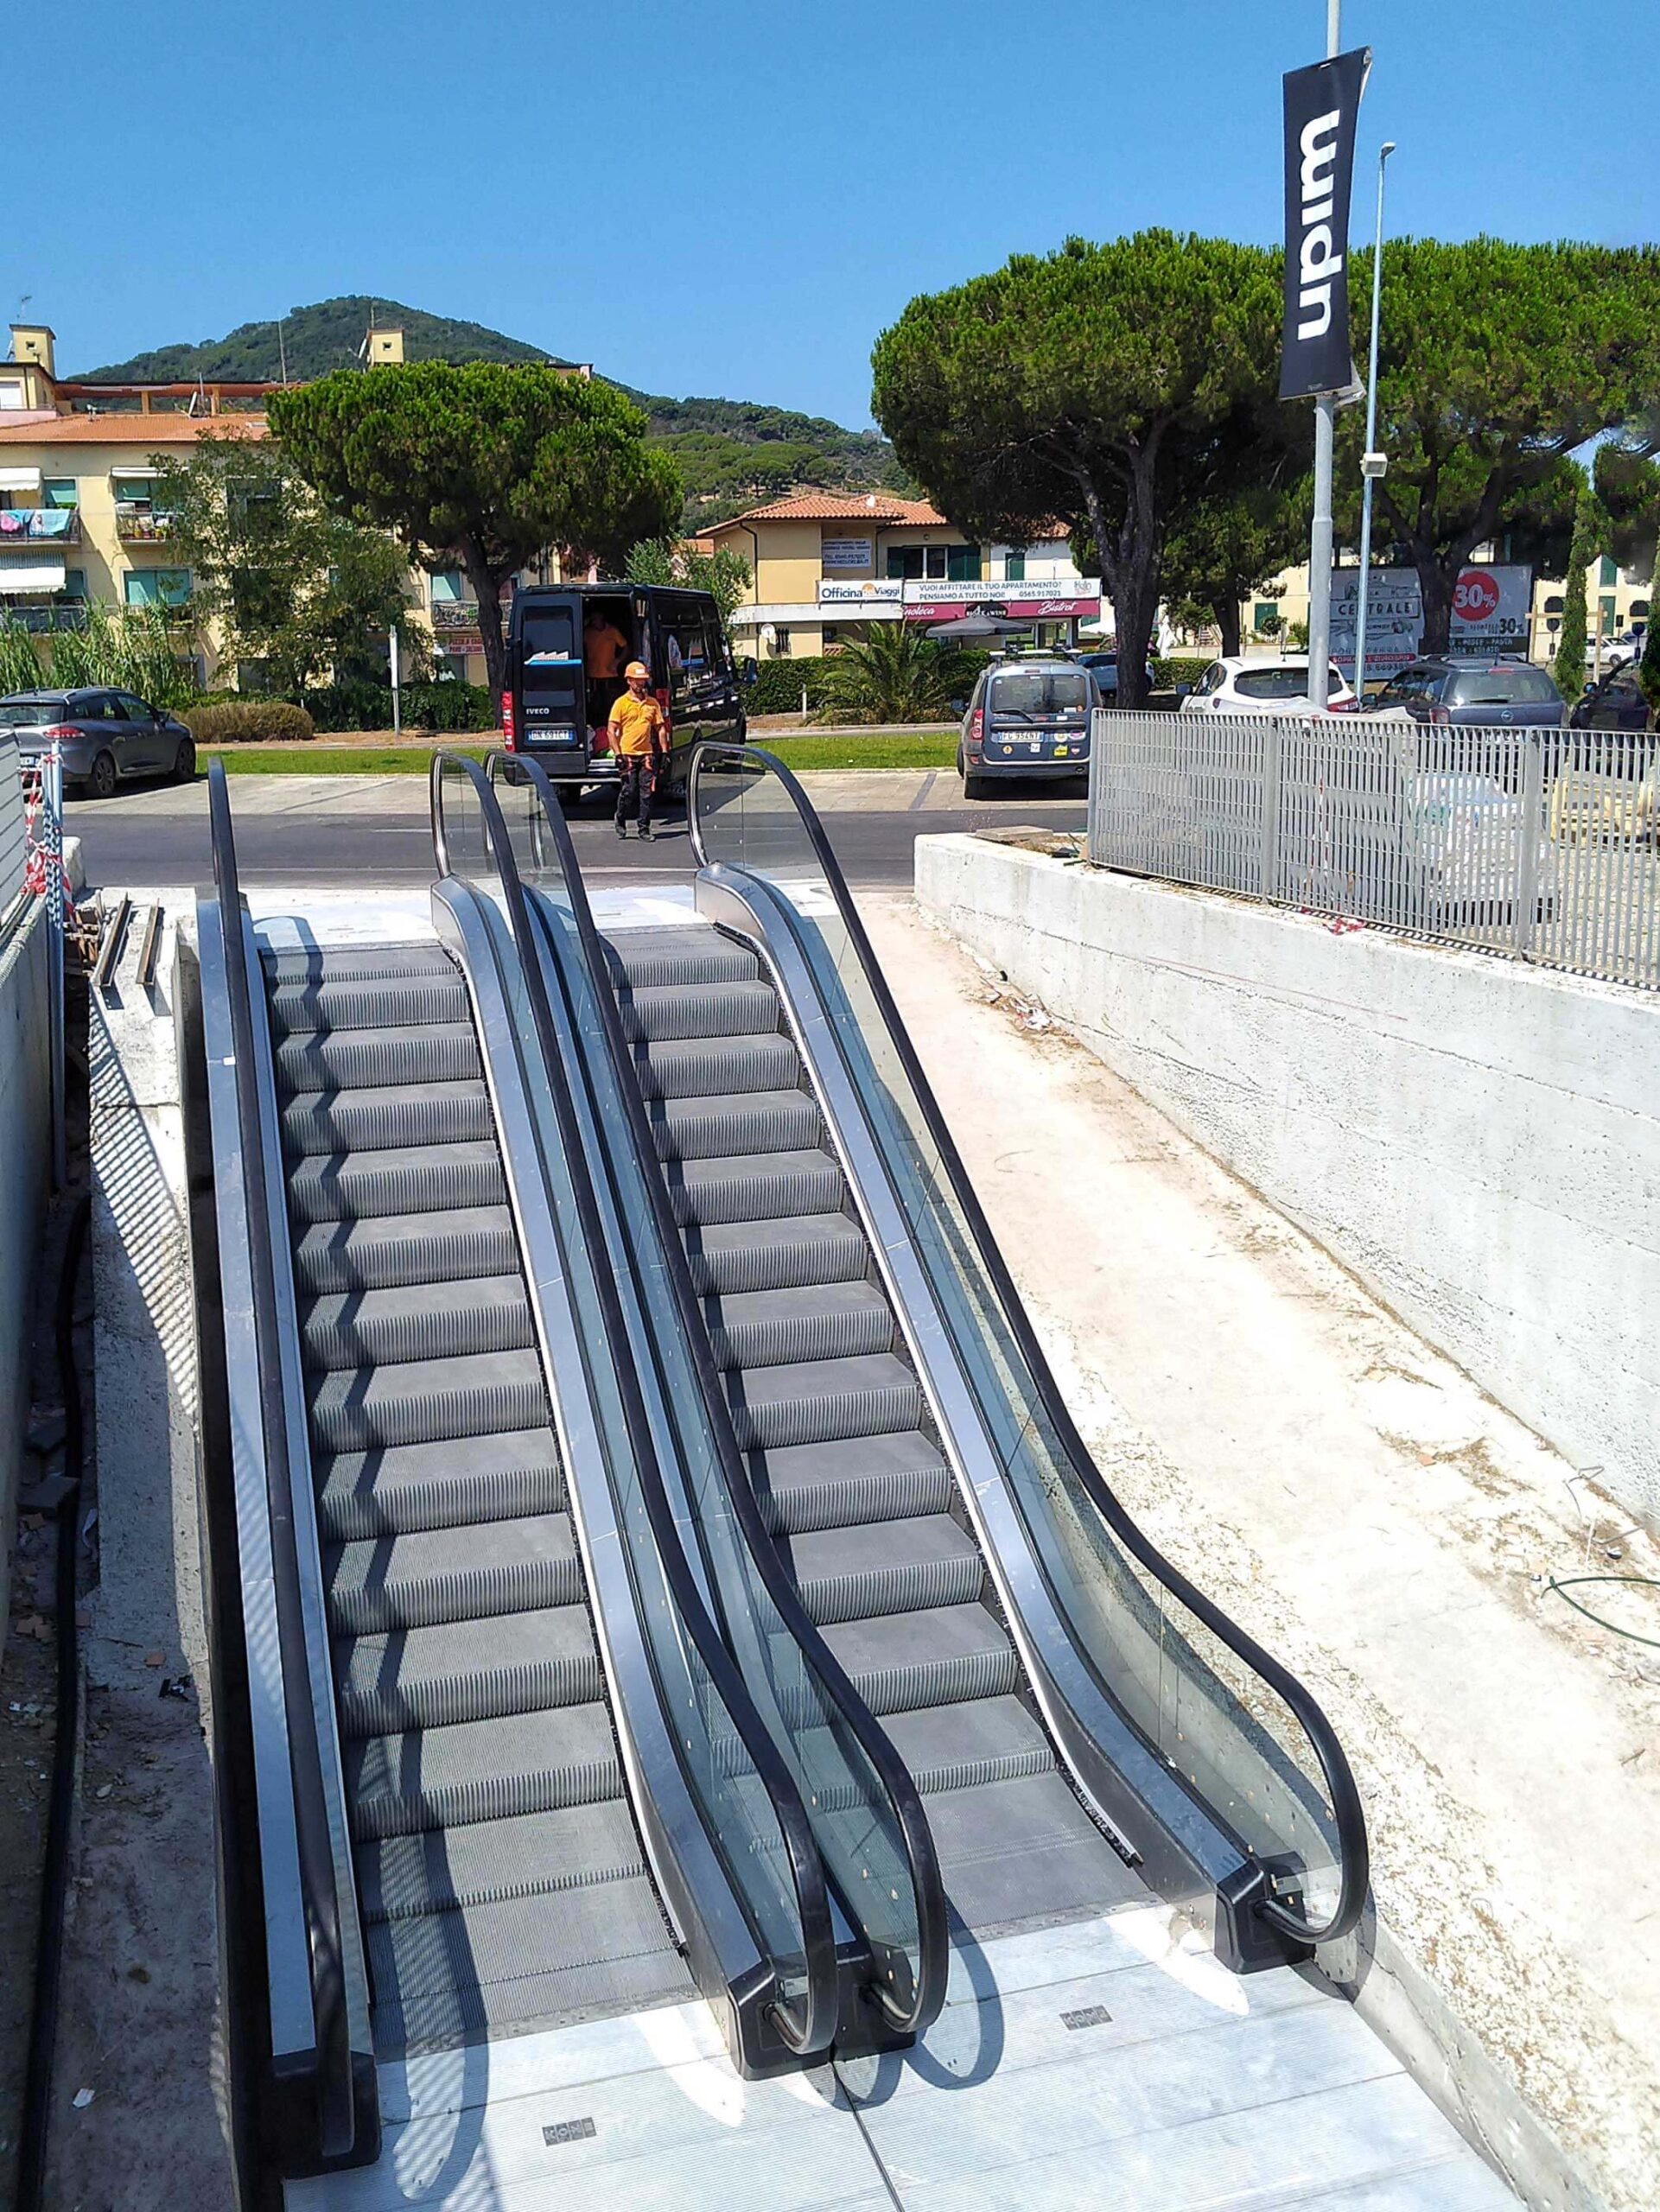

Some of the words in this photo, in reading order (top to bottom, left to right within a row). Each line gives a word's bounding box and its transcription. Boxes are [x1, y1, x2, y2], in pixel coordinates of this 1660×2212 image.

[1297, 110, 1342, 341] upim
[822, 588, 862, 598] Officina
[875, 588, 900, 597] Viaggi
[1455, 584, 1496, 608] 30%
[1038, 601, 1078, 615] Bistrot
